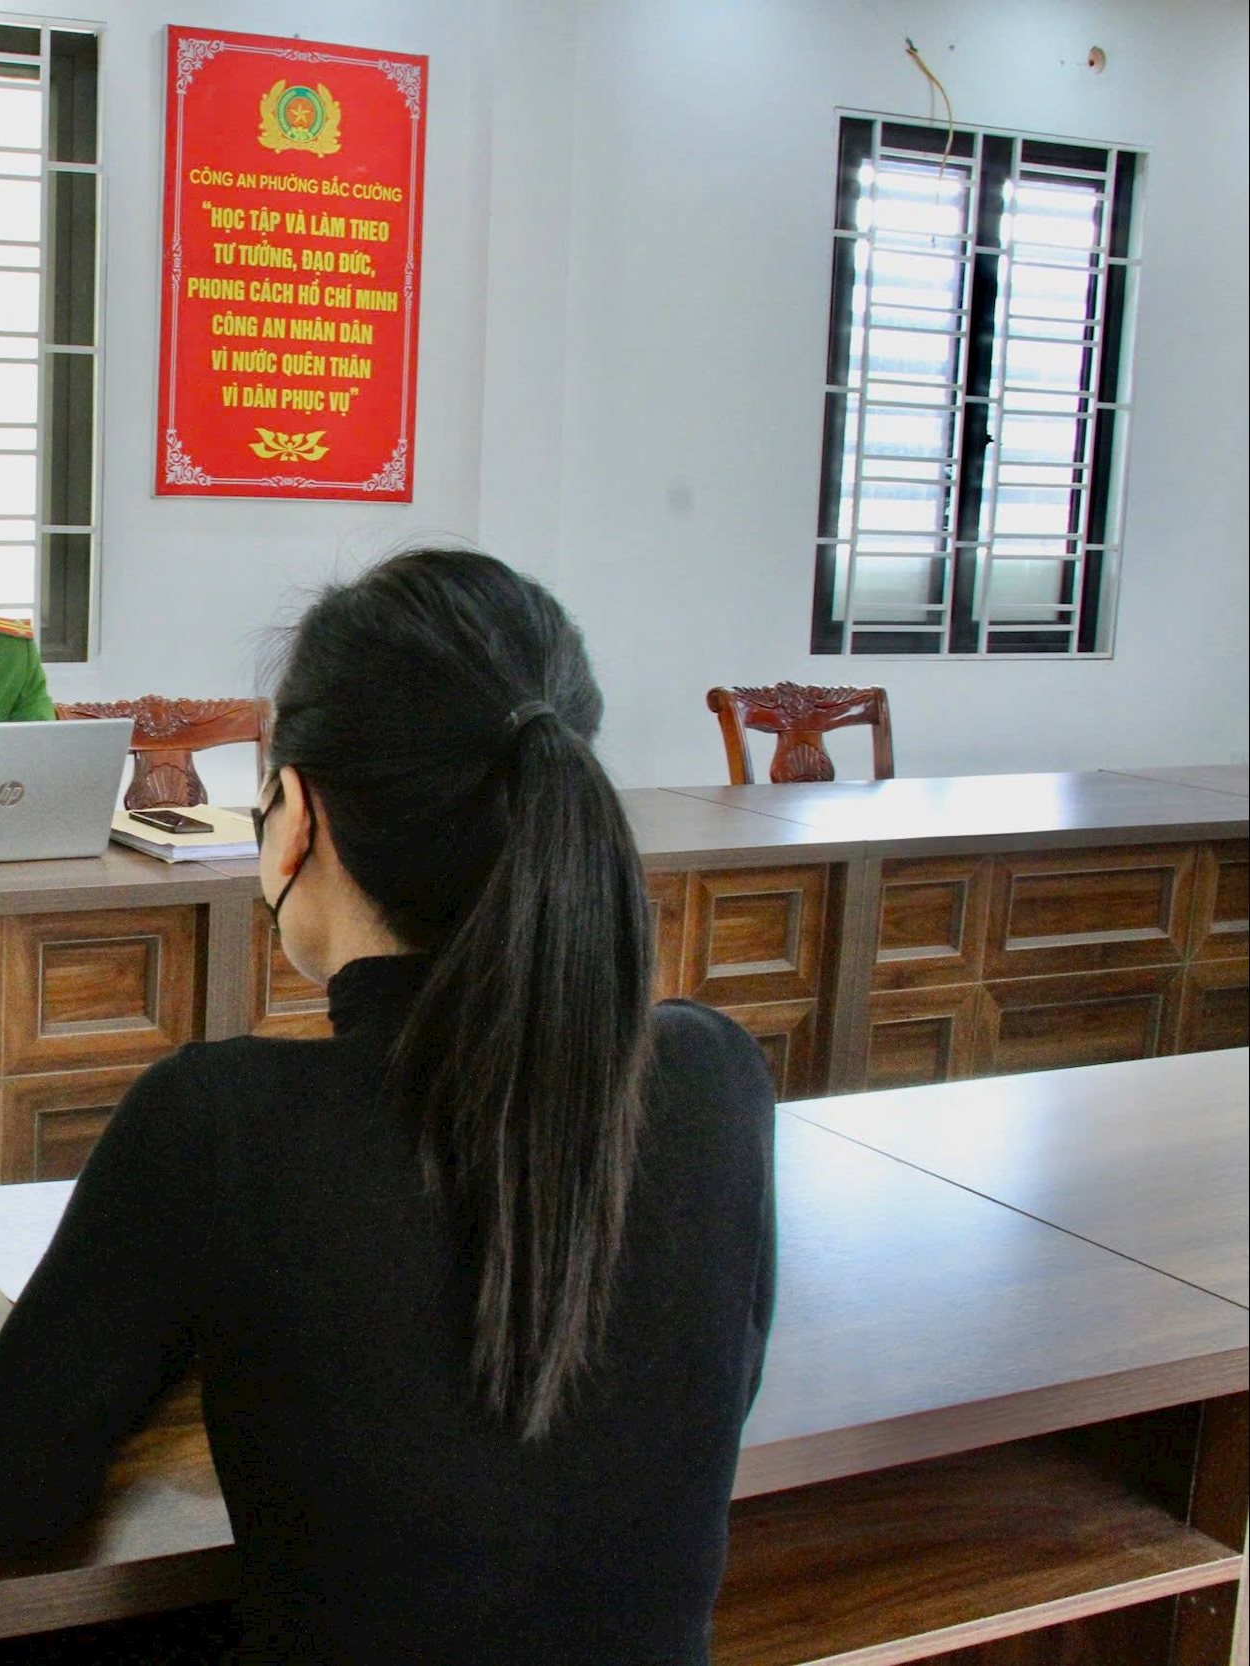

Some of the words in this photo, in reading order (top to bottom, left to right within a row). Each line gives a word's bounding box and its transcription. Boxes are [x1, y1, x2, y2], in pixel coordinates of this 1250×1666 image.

[190, 167, 233, 186] CÔNG
[237, 174, 256, 188] AN
[260, 173, 318, 194] PHƯỜNG
[322, 176, 349, 196] BẮC
[250, 207, 280, 236] TẬP
[311, 211, 345, 238] LÀM
[350, 219, 389, 242] THEO
[214, 242, 236, 264] TƯ
[238, 240, 297, 272] TƯỞNG,
[302, 250, 334, 275] ĐẠO
[339, 250, 376, 278] ĐỨC,
[188, 277, 244, 301] PHONG
[250, 279, 294, 305] CÁCH
[325, 285, 351, 308] CHÍ
[356, 289, 398, 312] MINH
[212, 311, 258, 336] CÔNG
[263, 319, 286, 338] AN
[290, 316, 335, 342] NHÂN
[340, 320, 373, 344] DÂN
[212, 346, 227, 371] VÌ
[233, 348, 277, 374] NƯỚC
[282, 352, 325, 376] QUÊN
[330, 354, 371, 379] THÂN
[222, 382, 237, 407] VÌ
[243, 384, 276, 409] DÂN
[281, 389, 324, 415] PHỤC
